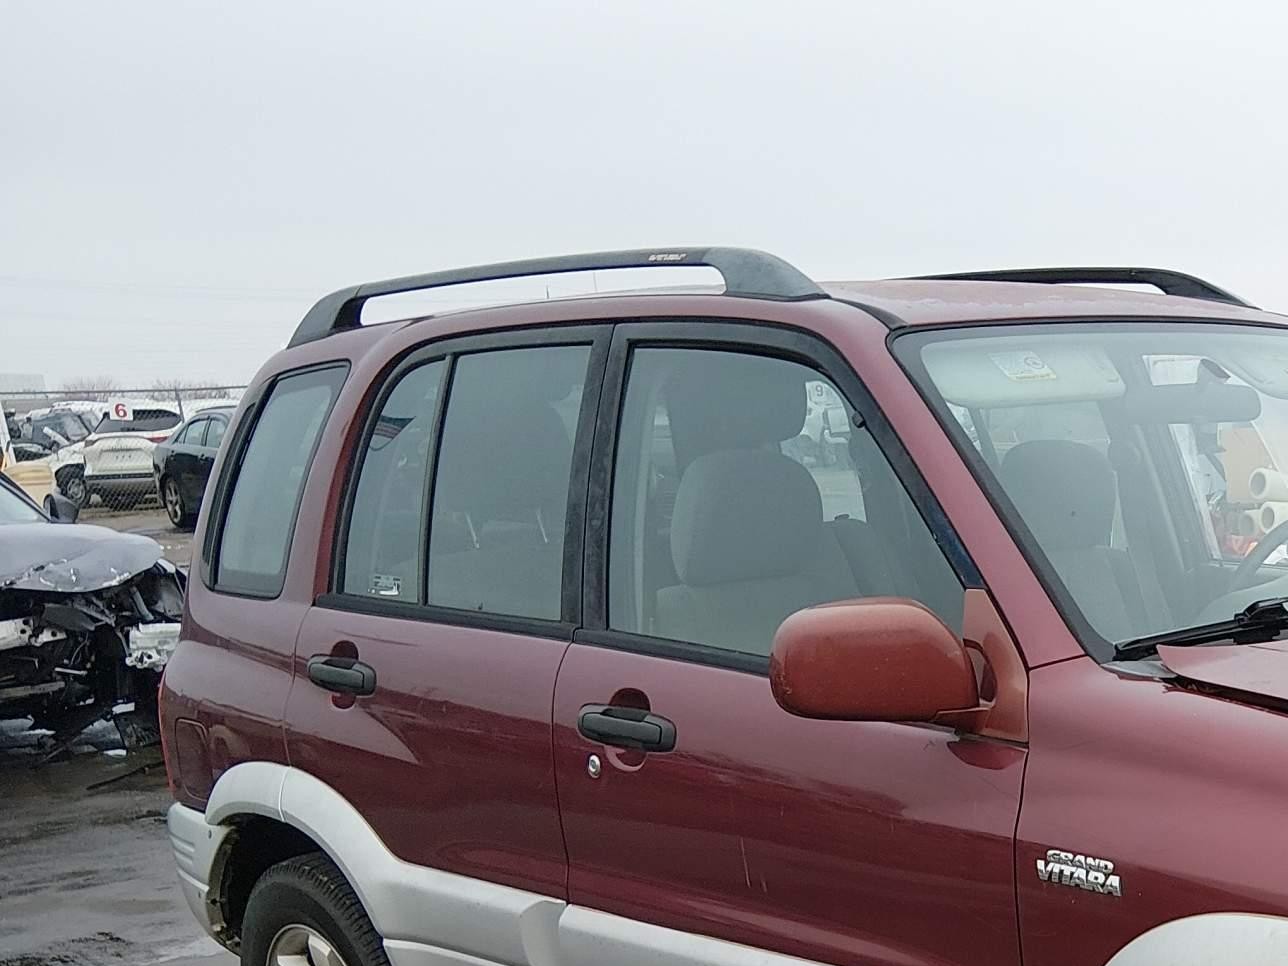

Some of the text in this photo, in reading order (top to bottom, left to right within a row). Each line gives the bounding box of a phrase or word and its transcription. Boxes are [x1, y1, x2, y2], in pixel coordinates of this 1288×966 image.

[114, 403, 127, 418] 6
[1046, 849, 1114, 873] GRAND
[1036, 859, 1122, 897] VITARA
